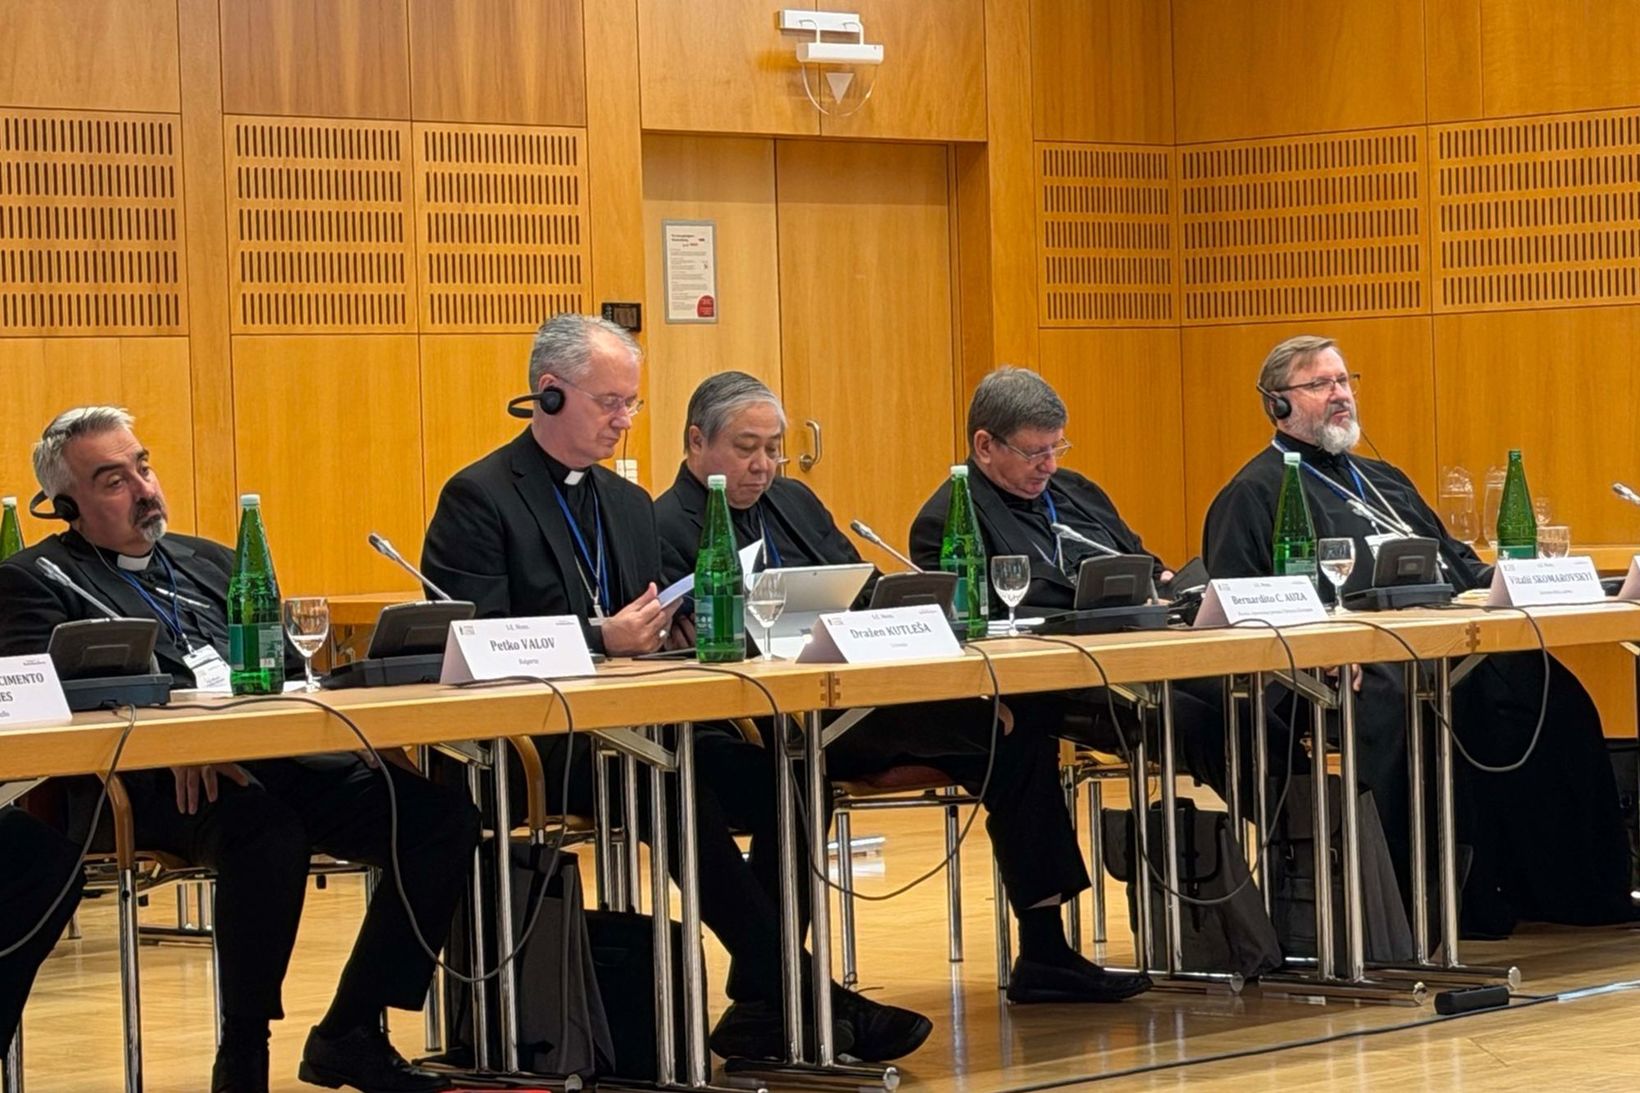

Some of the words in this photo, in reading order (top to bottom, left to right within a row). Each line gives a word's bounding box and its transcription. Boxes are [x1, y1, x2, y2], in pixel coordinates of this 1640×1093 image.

[1231, 595, 1276, 605] Bernardito
[1284, 592, 1308, 603] AUZA
[886, 621, 932, 636] KUTLEŠA
[489, 639, 520, 652] Petko
[520, 637, 556, 650] VALOV
